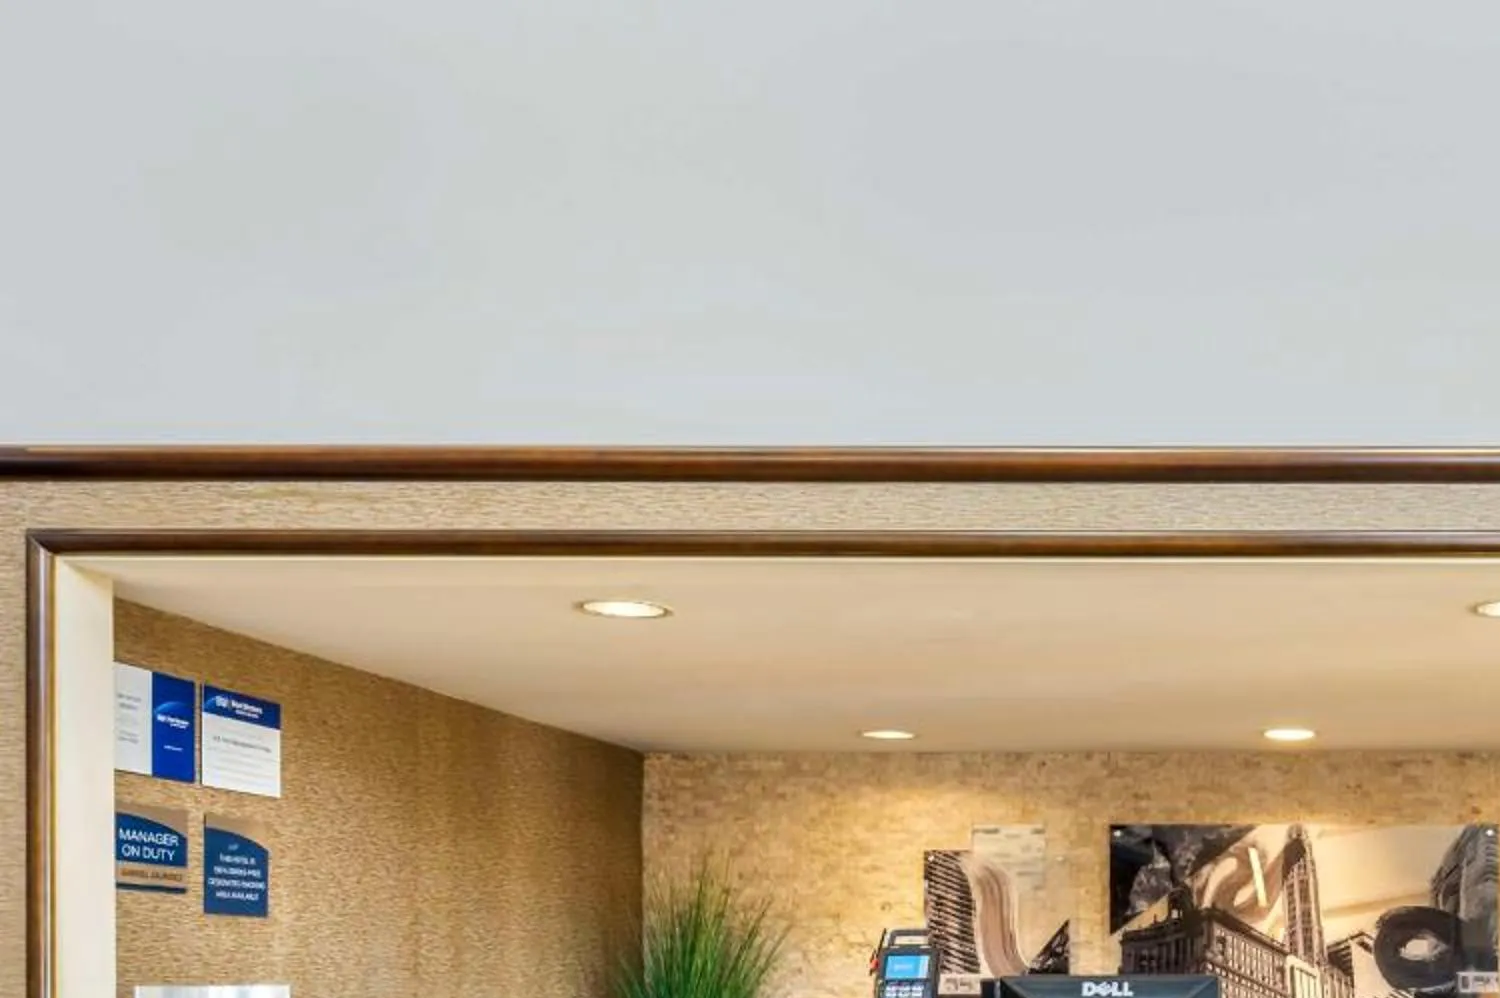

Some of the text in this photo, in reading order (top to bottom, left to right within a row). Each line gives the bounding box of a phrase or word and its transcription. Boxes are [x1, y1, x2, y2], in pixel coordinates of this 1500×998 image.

[119, 827, 179, 847] MANAGER
[121, 843, 176, 861] ON DUTY
[1081, 981, 1134, 997] DELL
